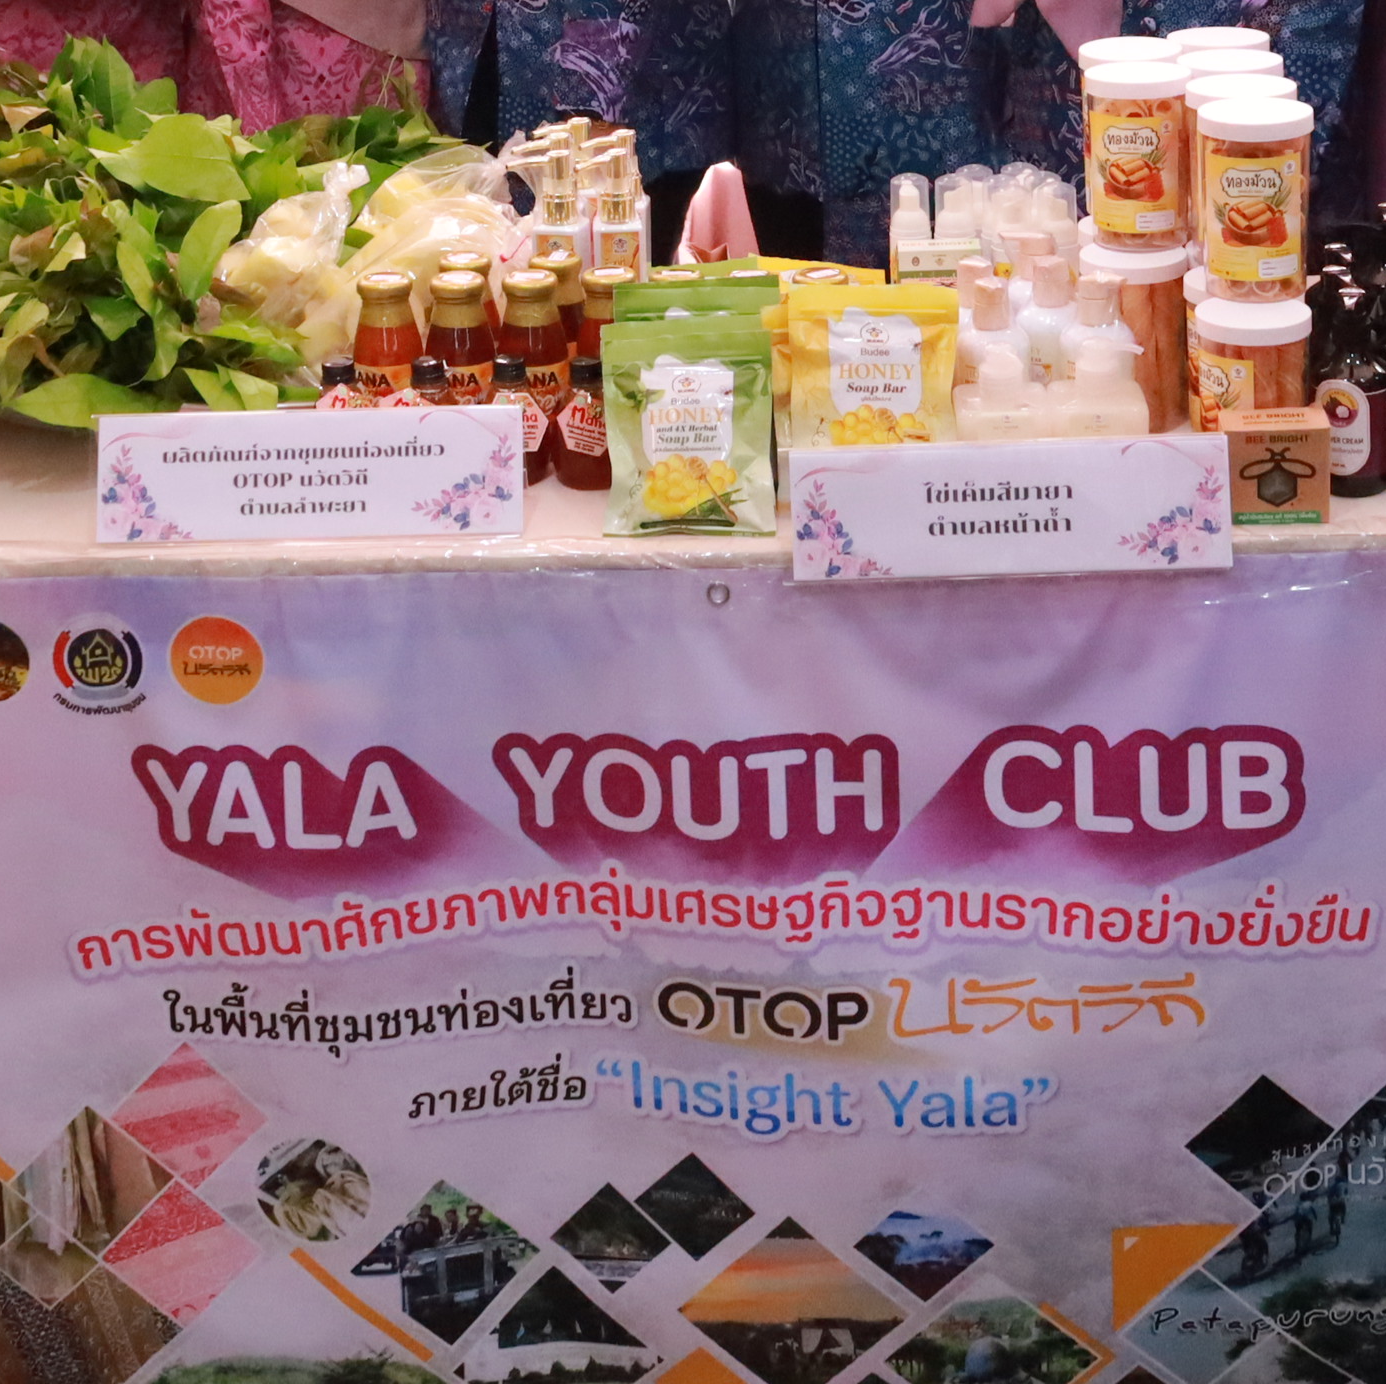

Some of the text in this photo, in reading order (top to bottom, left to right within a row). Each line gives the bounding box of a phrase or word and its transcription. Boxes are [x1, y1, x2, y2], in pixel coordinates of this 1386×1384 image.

[1106, 131, 1155, 147] ทองม้วน
[1225, 174, 1277, 189] ทองม้วน
[860, 347, 891, 357] Budee
[356, 371, 391, 388] ANA
[839, 363, 915, 380] HONEY
[846, 382, 908, 395] Soap Bar
[648, 406, 726, 425] HONEY
[656, 433, 717, 446] Soap Bar
[1245, 434, 1309, 444] BEE BRIGHT
[162, 436, 445, 466] ผลิตภัณฑ์จากชุมชนท่องเที่ยว
[233, 468, 368, 488] OTOP นวัตวิถี
[240, 498, 367, 516] ตำบลลำพะยา
[928, 508, 1072, 536] ตำบลหน้าถ้ำ
[188, 645, 243, 661] OTOP
[145, 740, 1290, 850] YALA YOUTH CLUB
[76, 867, 1371, 971] การพัฒนาศักยภาพกลุ่มเศรษฐกิจฐานรากอย่างยั่งยืน
[162, 966, 634, 1058] ในพื้นที่ชุมชนท่องเที่ยว
[657, 981, 869, 1041] OTOP
[408, 1053, 1051, 1136] ภายใต้ชื่อ “Insight Yala”
[1263, 1164, 1337, 1198] OTOP
